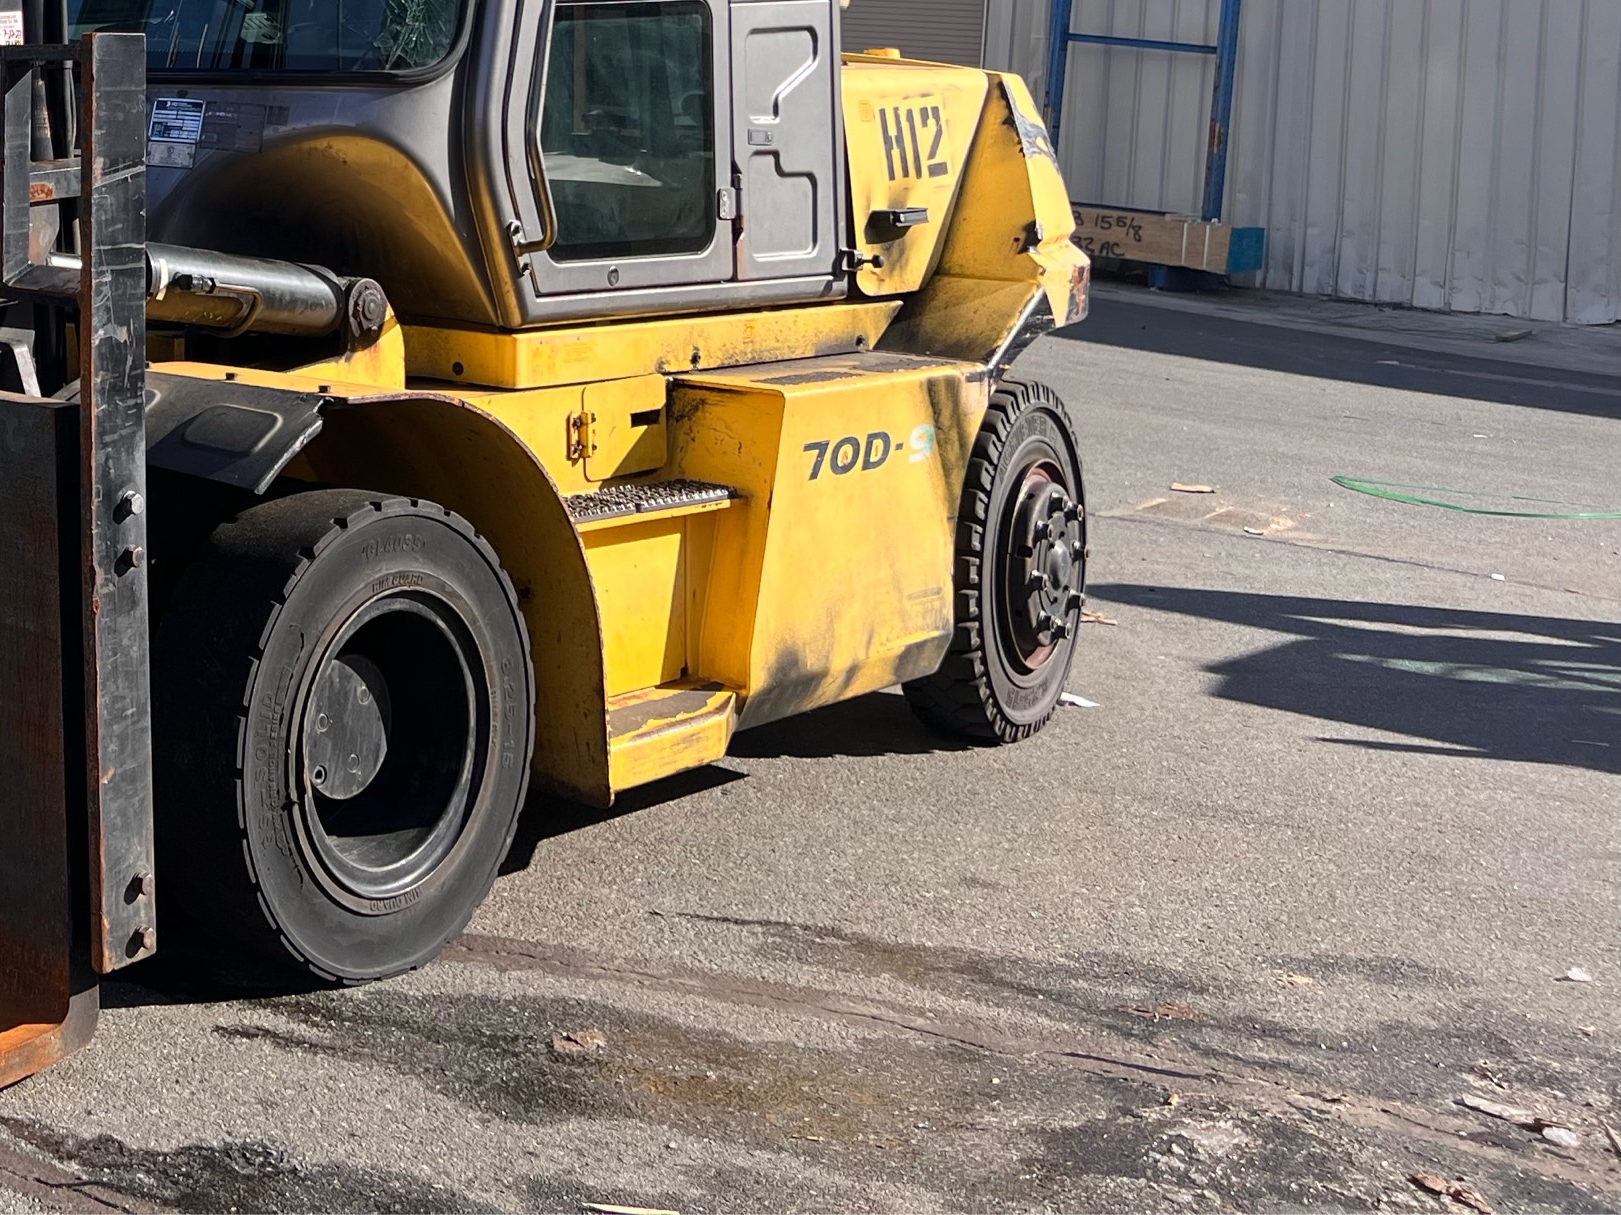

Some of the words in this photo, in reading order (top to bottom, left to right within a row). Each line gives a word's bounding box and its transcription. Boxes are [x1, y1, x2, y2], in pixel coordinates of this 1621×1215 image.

[878, 106, 949, 181] H12
[1099, 241, 1125, 257] AC
[802, 423, 936, 482] 70D-9
